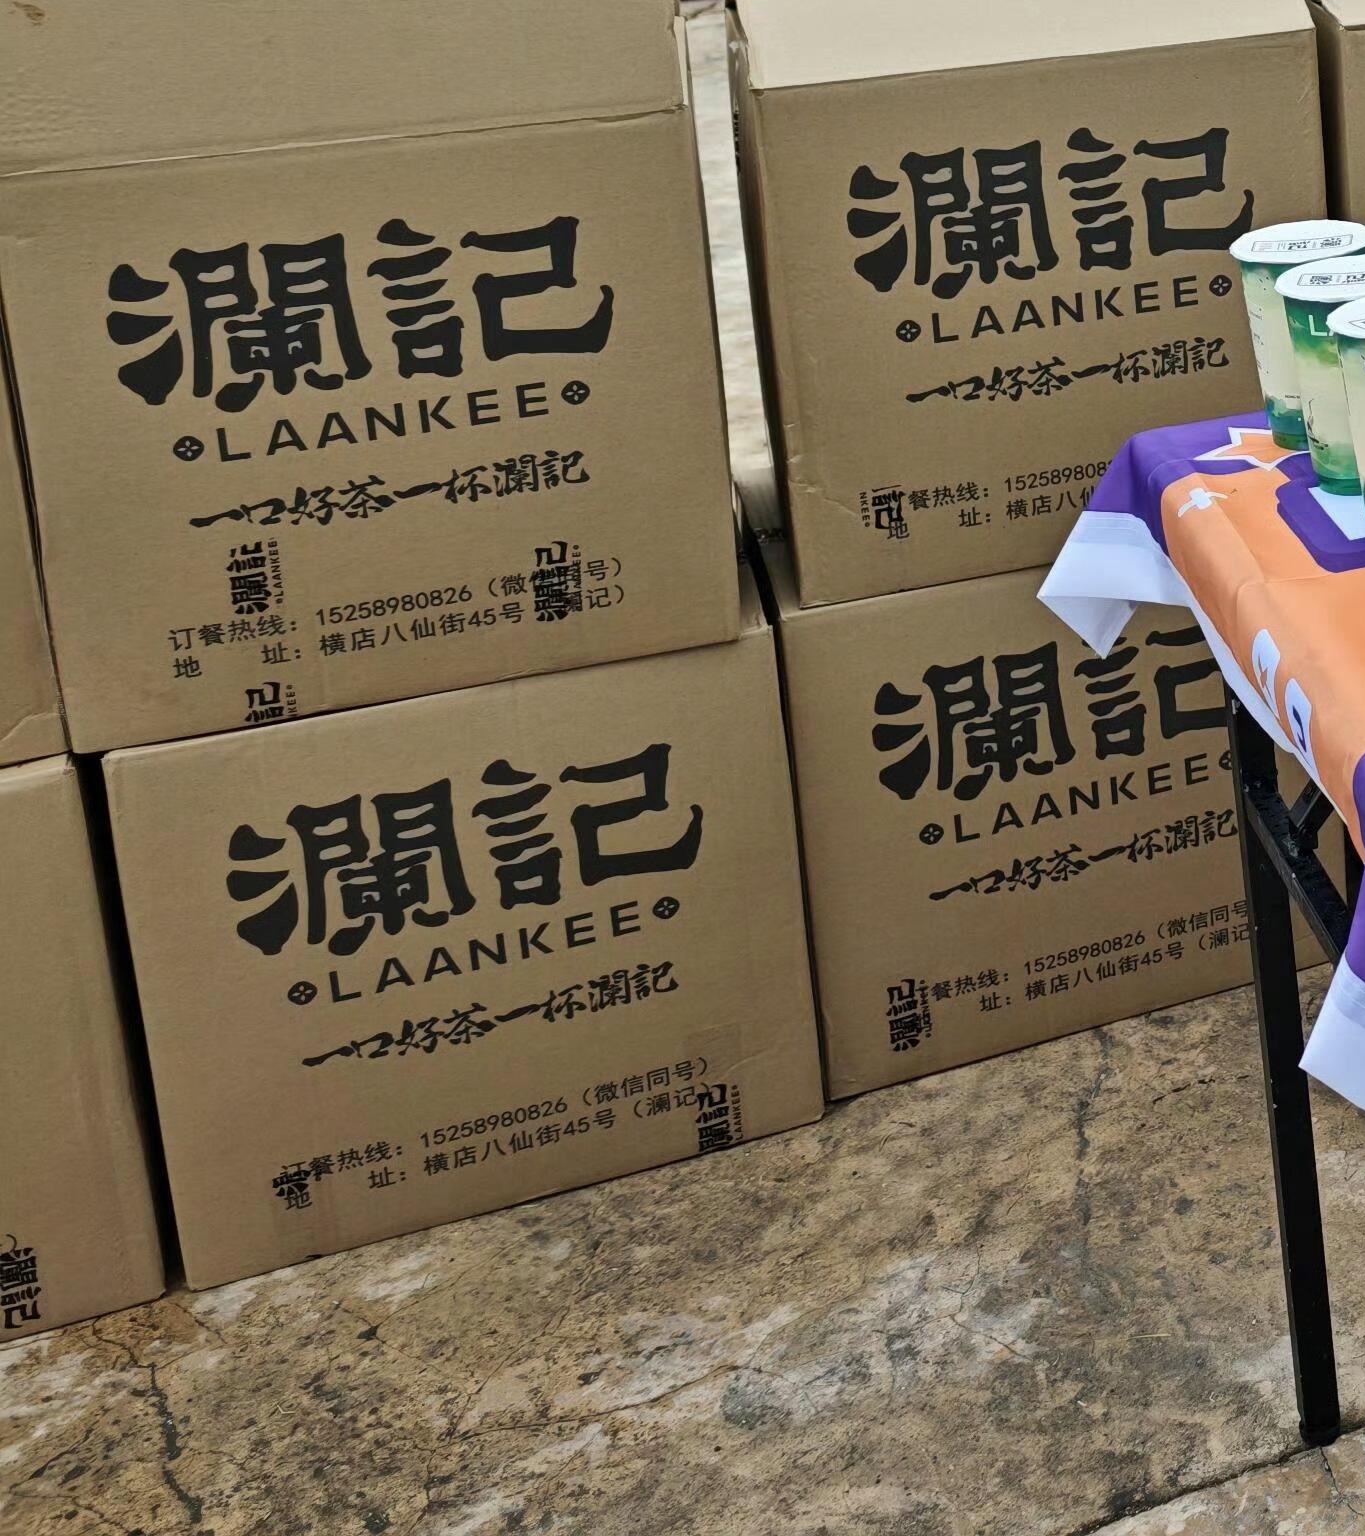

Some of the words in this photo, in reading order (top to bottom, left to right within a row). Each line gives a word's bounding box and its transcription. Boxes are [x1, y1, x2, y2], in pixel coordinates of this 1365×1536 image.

[845, 126, 1255, 301] 瀾記
[106, 215, 615, 414] 瀾記
[931, 273, 1201, 344] LAANKEE
[217, 380, 551, 463] LAANKEE
[871, 626, 1231, 801] 瀾記
[226, 742, 704, 958] 瀾記
[954, 753, 1211, 844] LAANKEE
[328, 898, 645, 1004] LAANKEE
